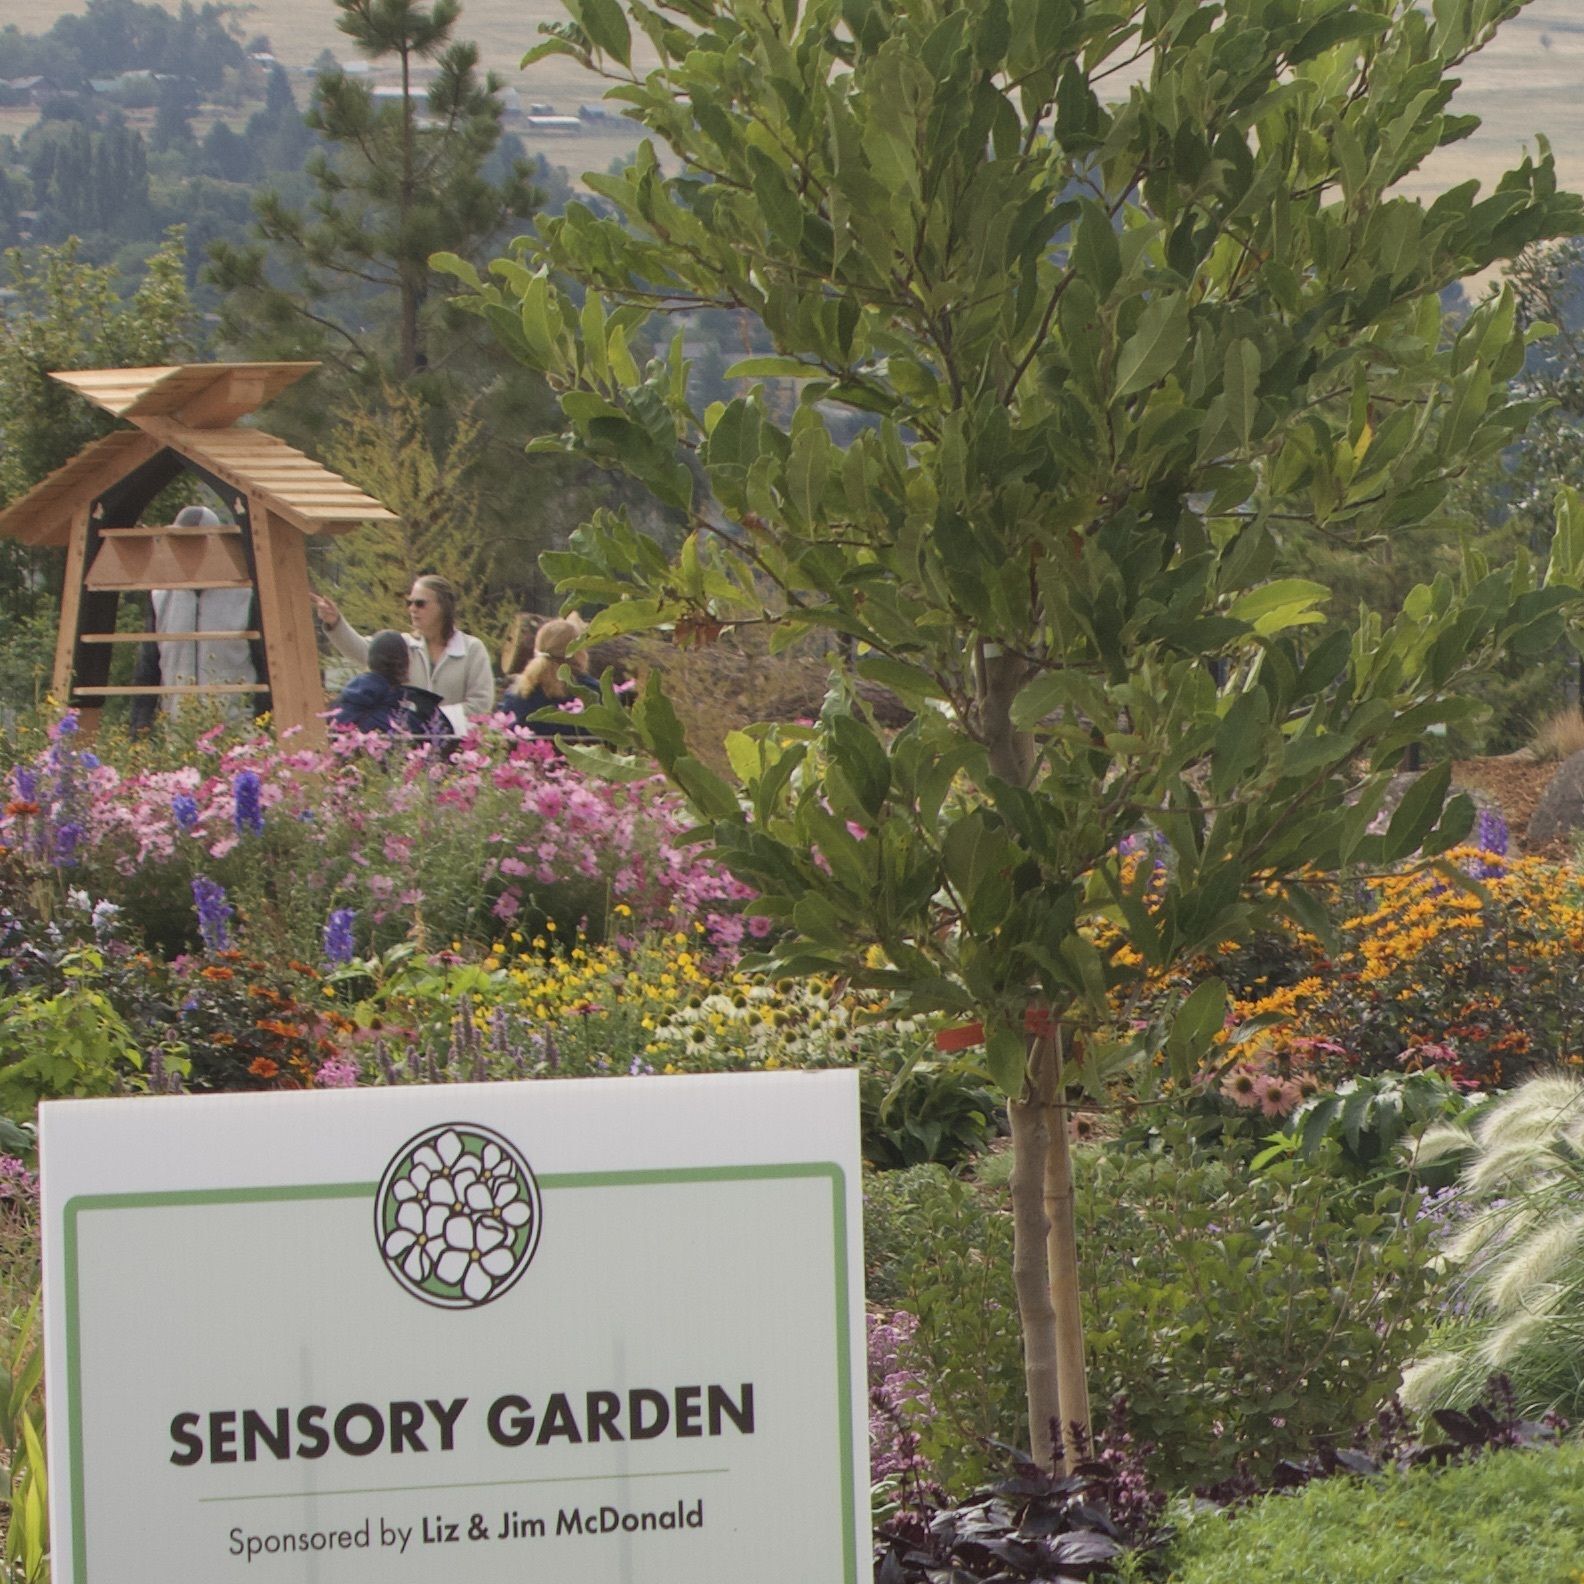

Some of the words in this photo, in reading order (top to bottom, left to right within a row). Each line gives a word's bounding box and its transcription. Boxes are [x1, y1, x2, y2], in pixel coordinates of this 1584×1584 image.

[169, 1397, 469, 1467] SENSORY
[486, 1382, 755, 1448] GARDEN
[229, 1517, 370, 1564] Sponsored
[380, 1517, 413, 1554] by
[422, 1515, 460, 1544] Liz
[467, 1513, 490, 1542] &
[497, 1510, 546, 1540] Jim
[555, 1498, 704, 1536] McDonald
